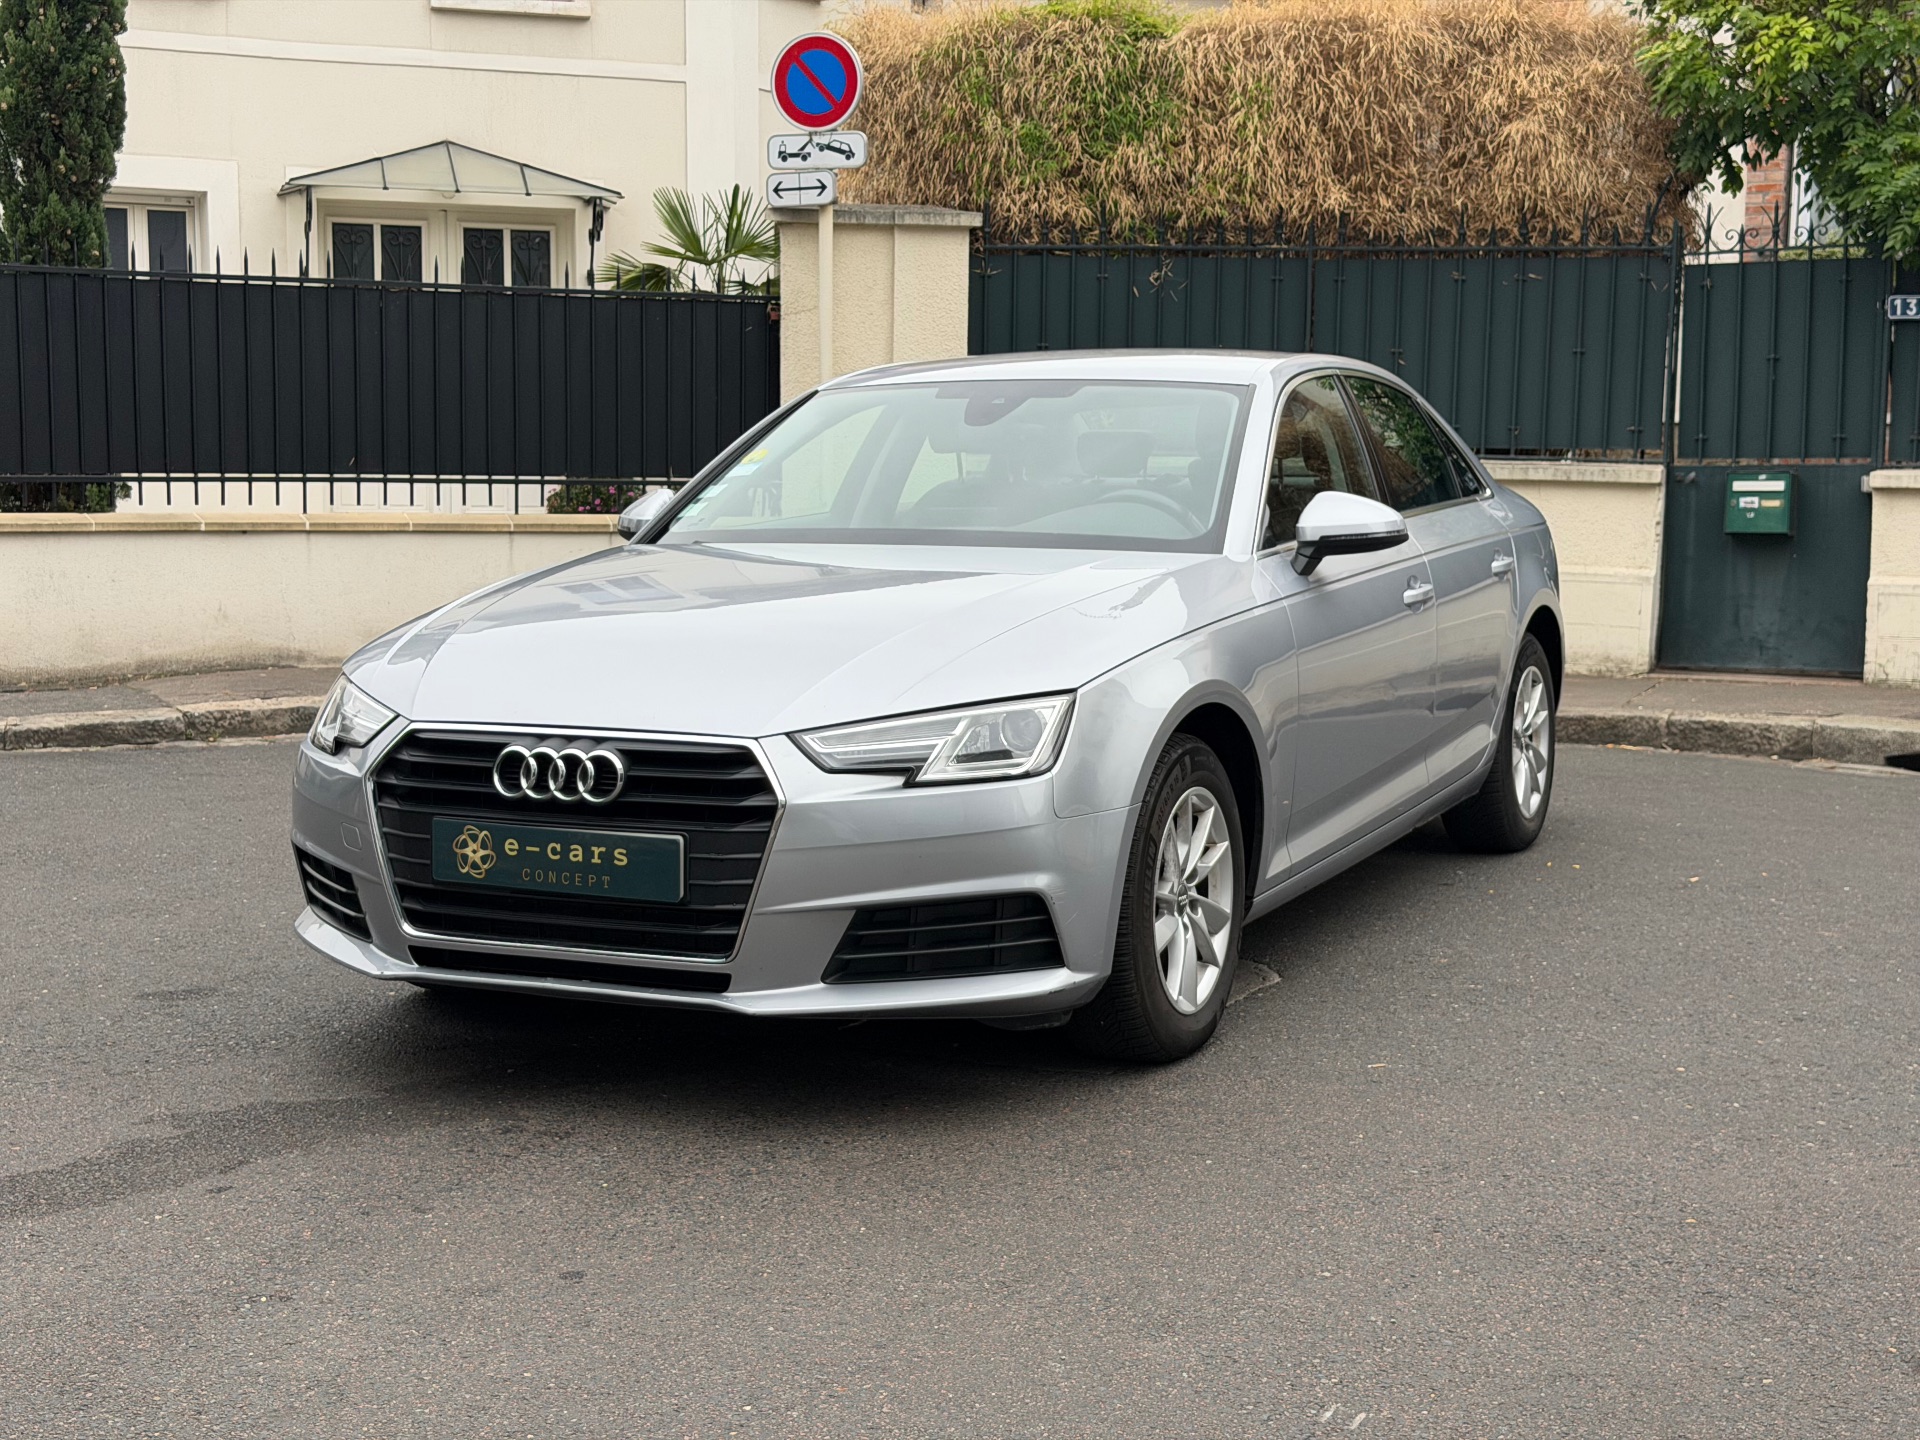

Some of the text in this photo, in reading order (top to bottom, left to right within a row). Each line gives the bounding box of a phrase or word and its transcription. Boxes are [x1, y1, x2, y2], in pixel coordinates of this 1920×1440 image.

[1893, 298, 1917, 316] 13
[504, 838, 628, 866] e-cars
[522, 868, 611, 889] CONCEPT
